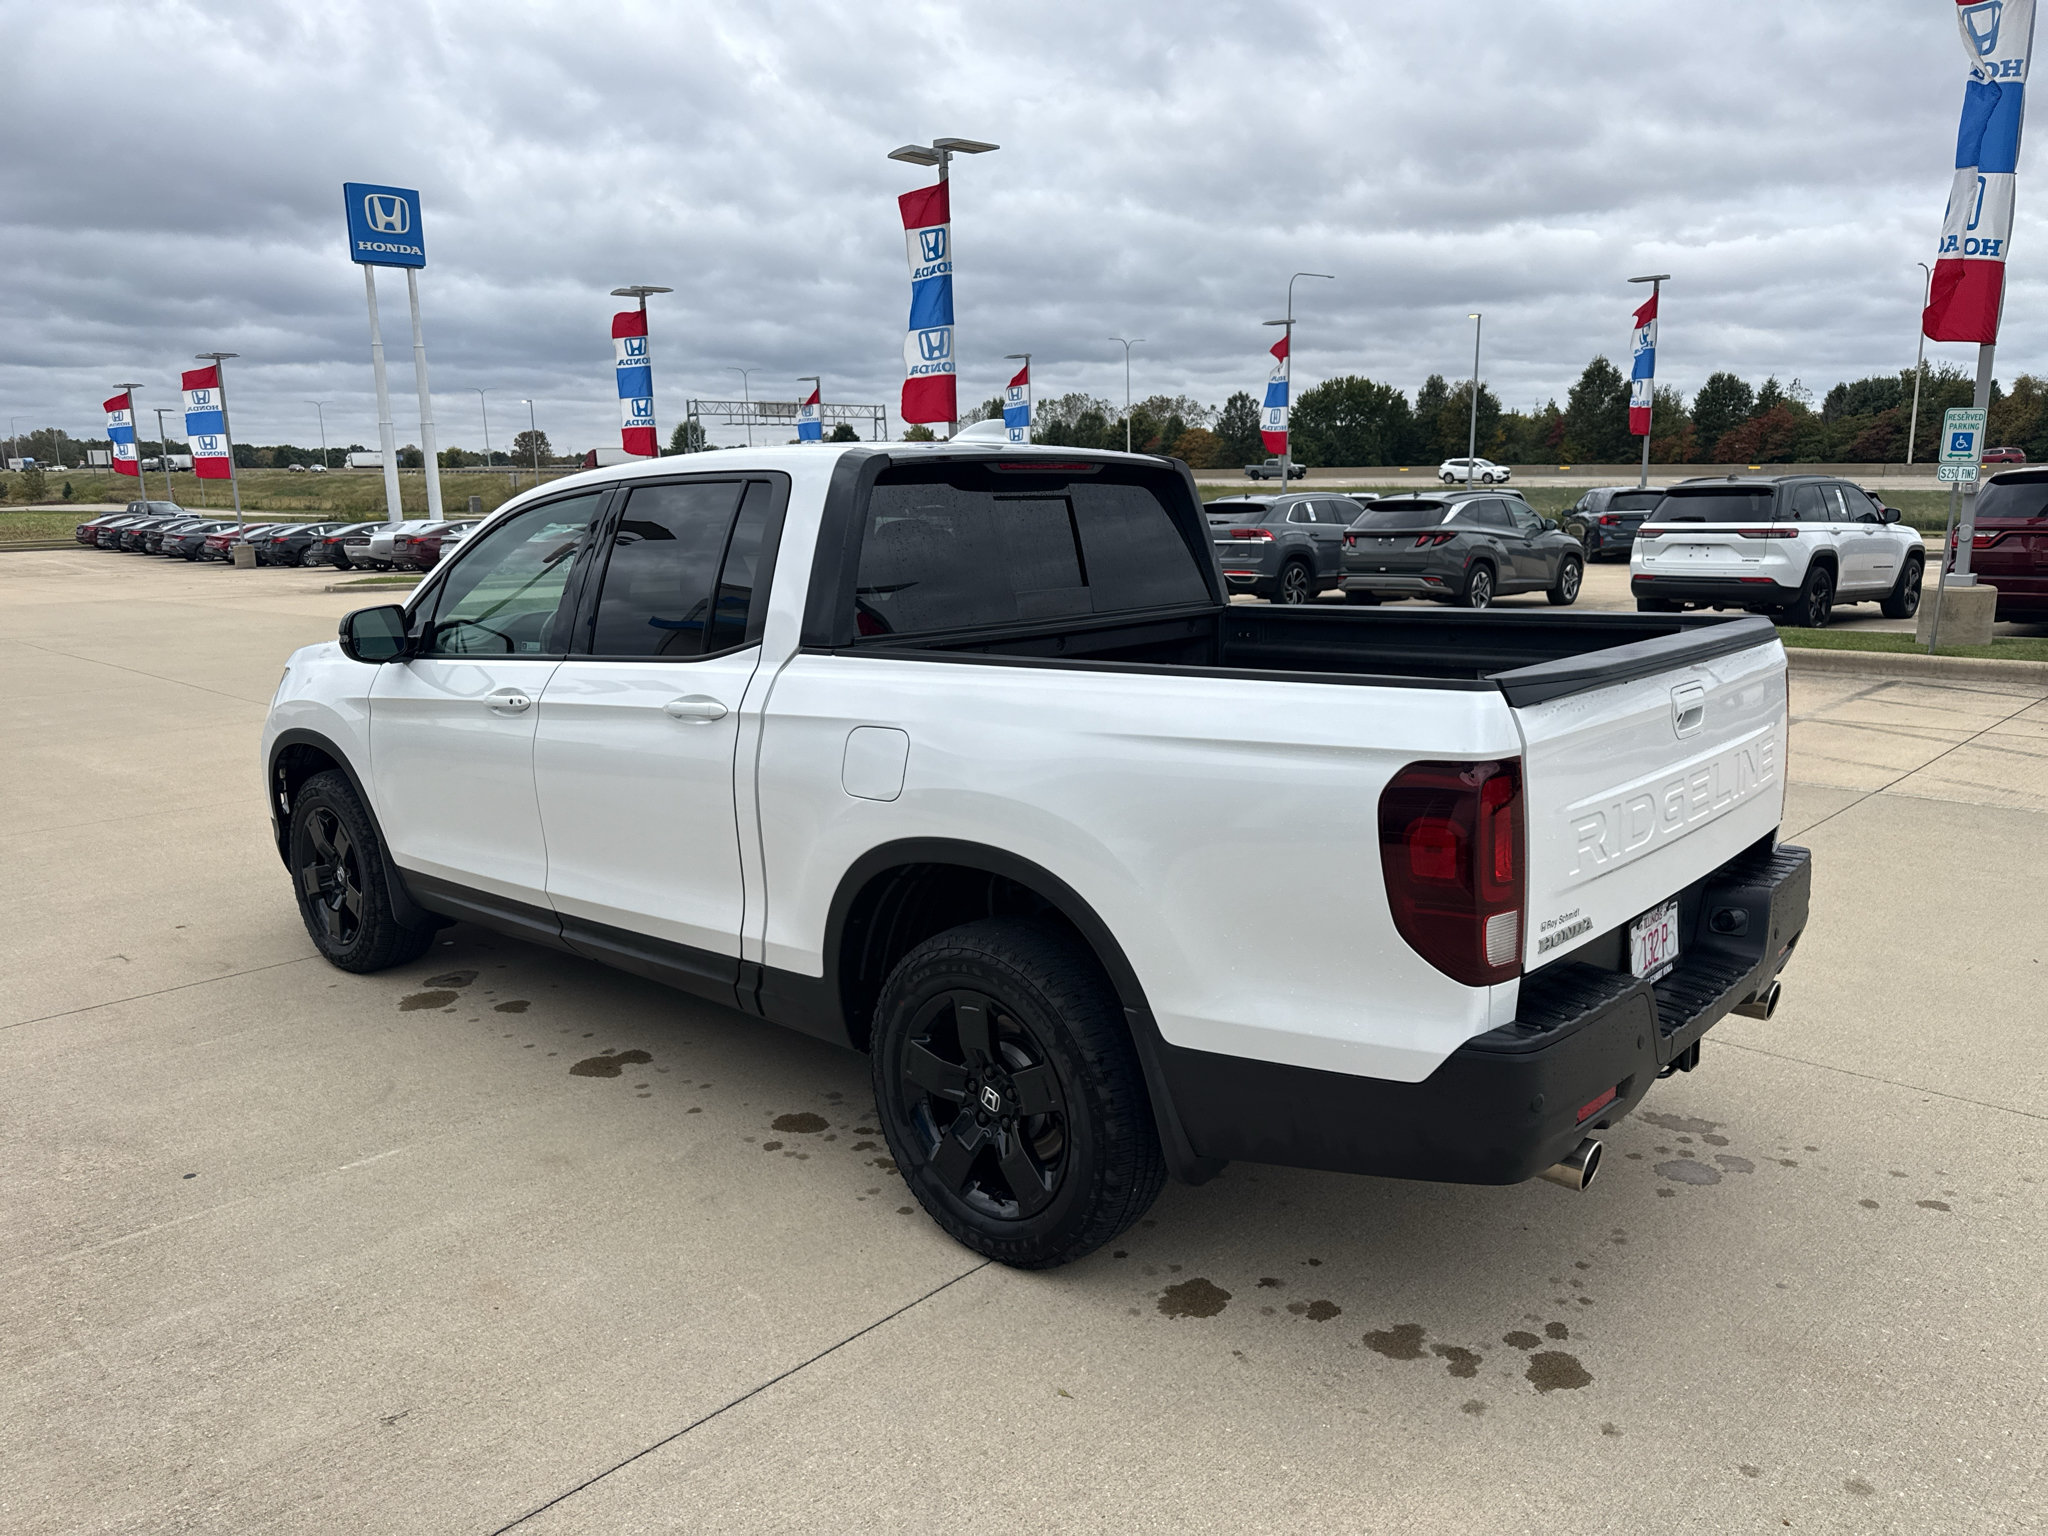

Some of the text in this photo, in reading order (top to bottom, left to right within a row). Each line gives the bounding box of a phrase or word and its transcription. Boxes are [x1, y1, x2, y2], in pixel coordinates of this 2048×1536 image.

[357, 240, 423, 256] HONDA
[1948, 413, 1984, 421] RESERVED
[1949, 422, 1980, 430] PARKING
[1961, 468, 1975, 479] FINE
[1568, 734, 1776, 876] RIDGELINE
[1537, 915, 1594, 954] HONDA
